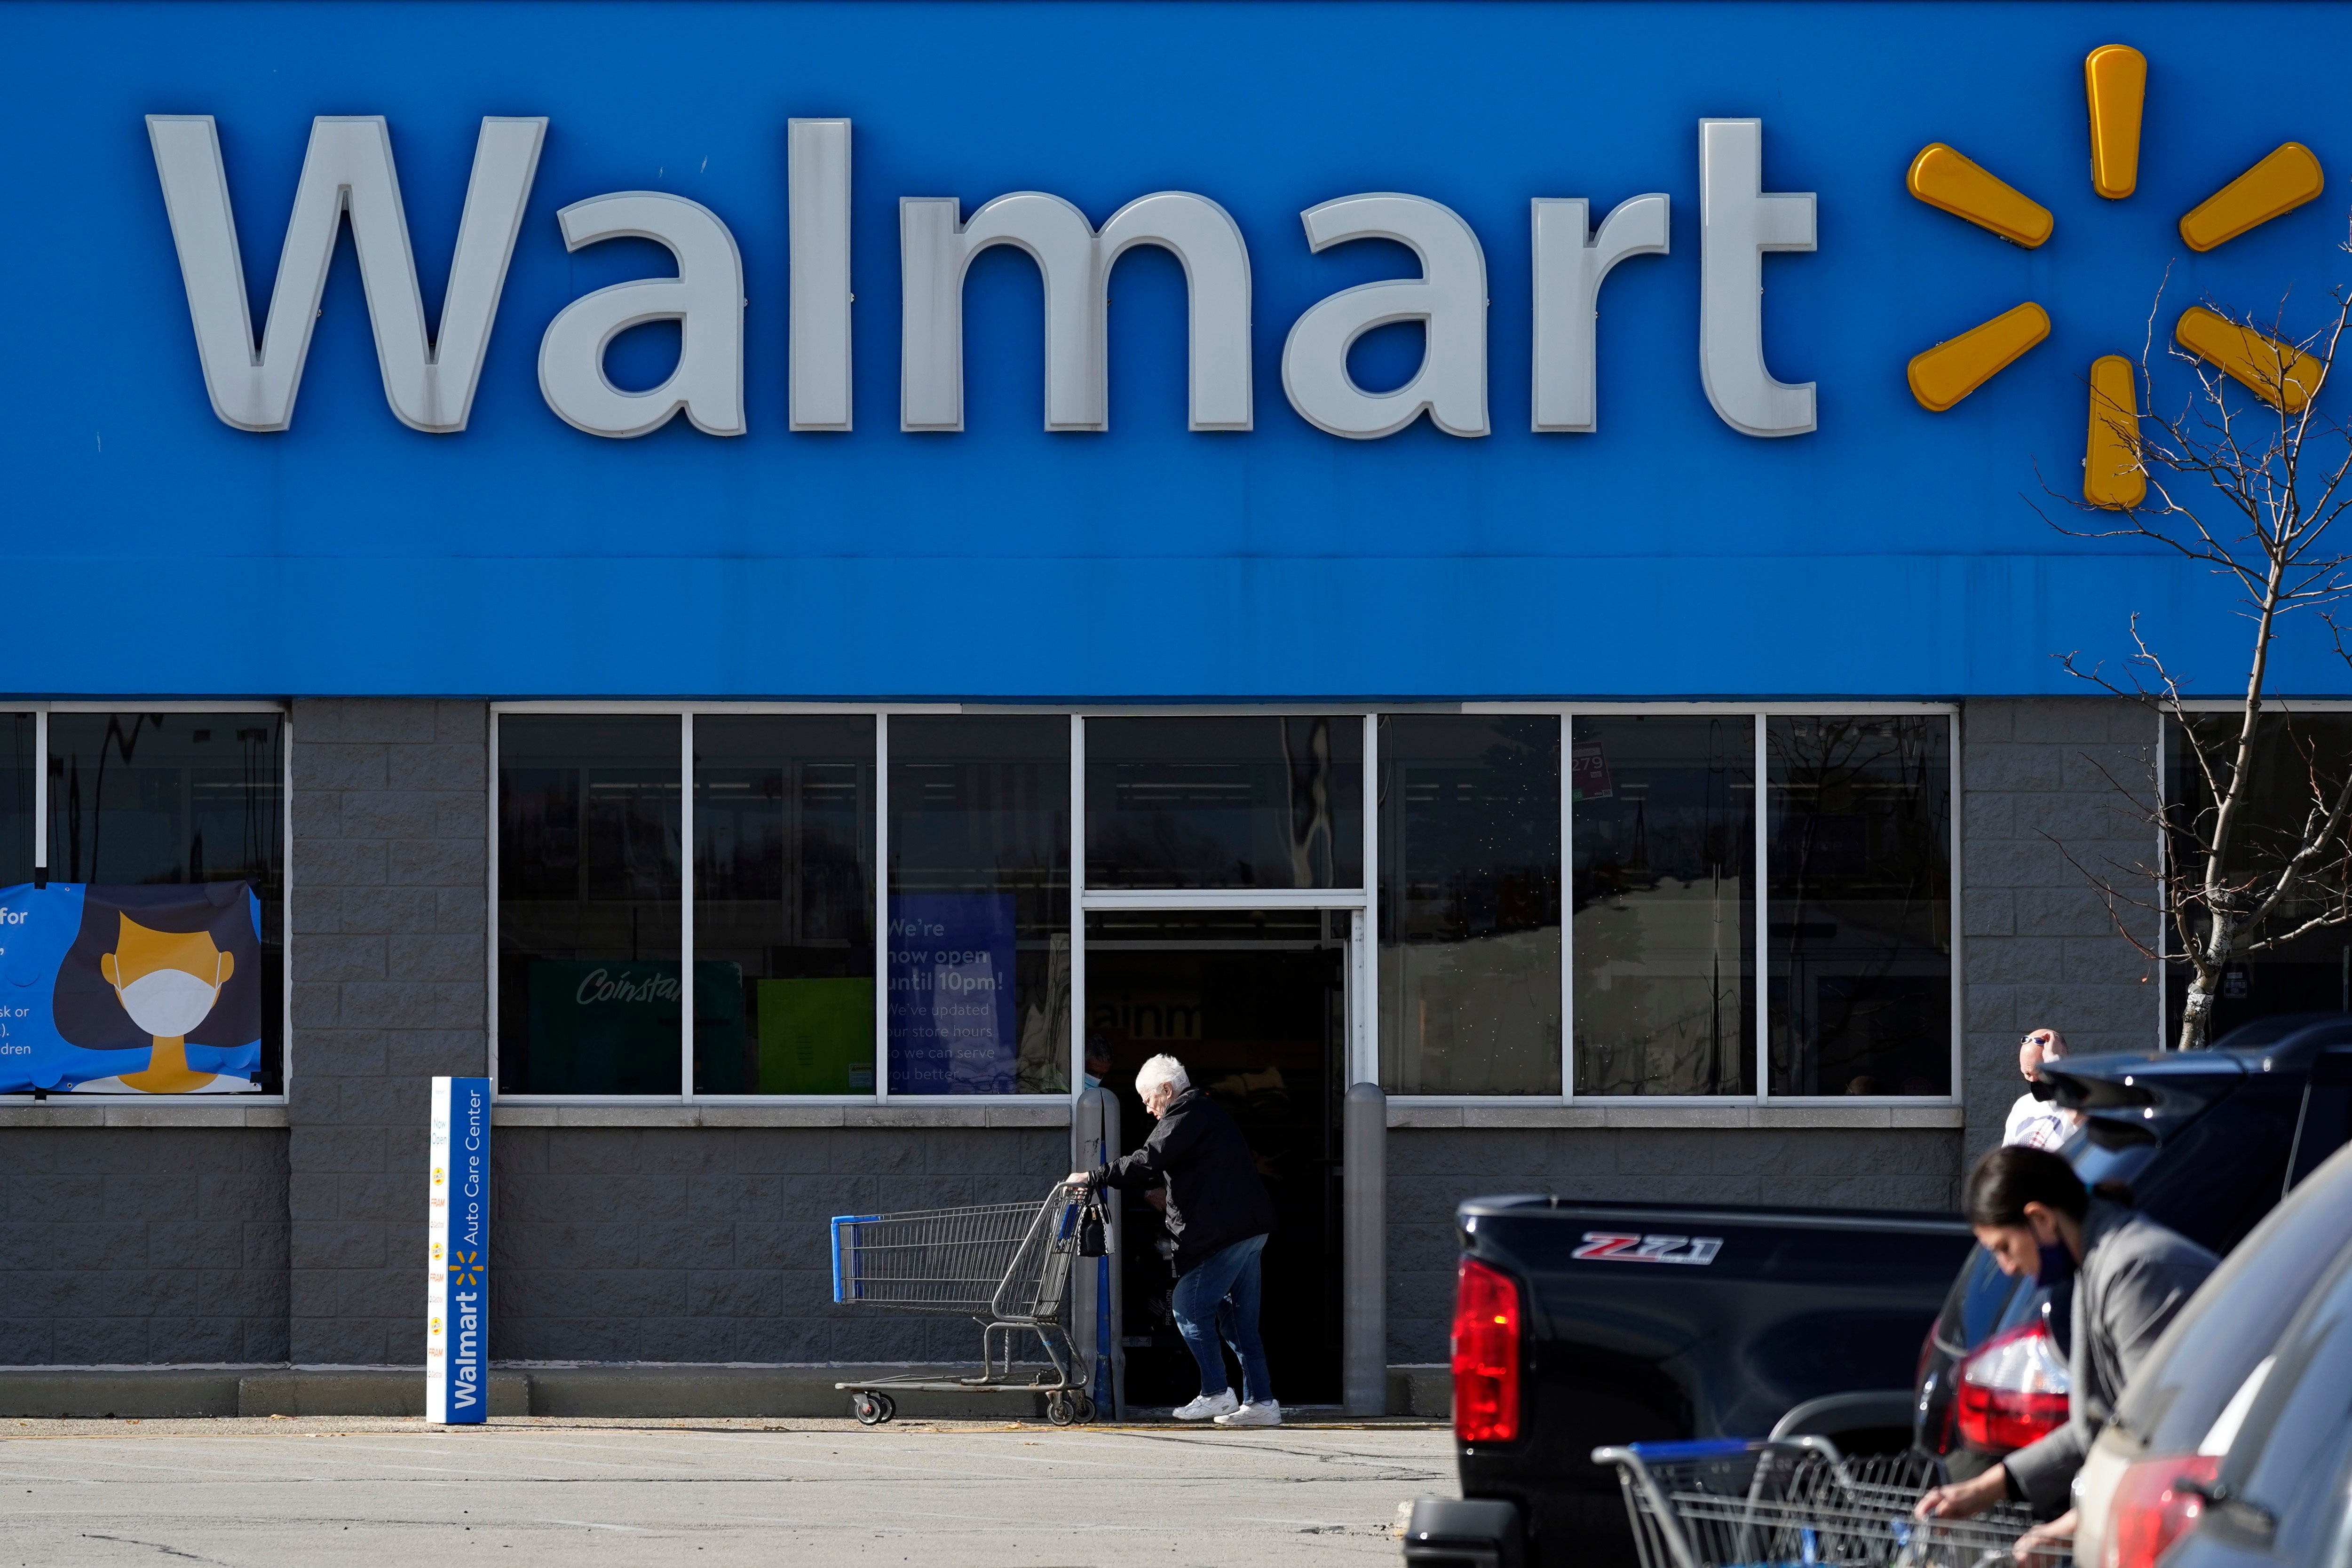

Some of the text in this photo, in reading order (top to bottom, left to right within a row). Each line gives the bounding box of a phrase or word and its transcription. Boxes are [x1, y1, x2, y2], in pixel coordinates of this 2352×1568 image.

[145, 114, 1817, 439] Walmart
[0, 907, 28, 925] for
[888, 919, 945, 937] We're
[888, 951, 987, 969] now open
[888, 972, 1003, 996] until 10pm!
[15, 1008, 30, 1017] or
[932, 1003, 989, 1019] updated
[912, 1026, 949, 1037] store
[953, 1025, 992, 1037] hours
[1, 1042, 31, 1055] dren
[904, 1049, 924, 1058] we
[928, 1049, 952, 1058] can
[957, 1049, 995, 1058] serve
[433, 1117, 446, 1129] Now
[432, 1132, 447, 1148] Open
[464, 1089, 481, 1246] Auto Care Center
[430, 1198, 445, 1207] FRAM
[1570, 1231, 1724, 1265] Z71
[429, 1273, 443, 1283] FRAM
[428, 1348, 443, 1358] FRAM
[455, 1291, 477, 1409] Walmart
